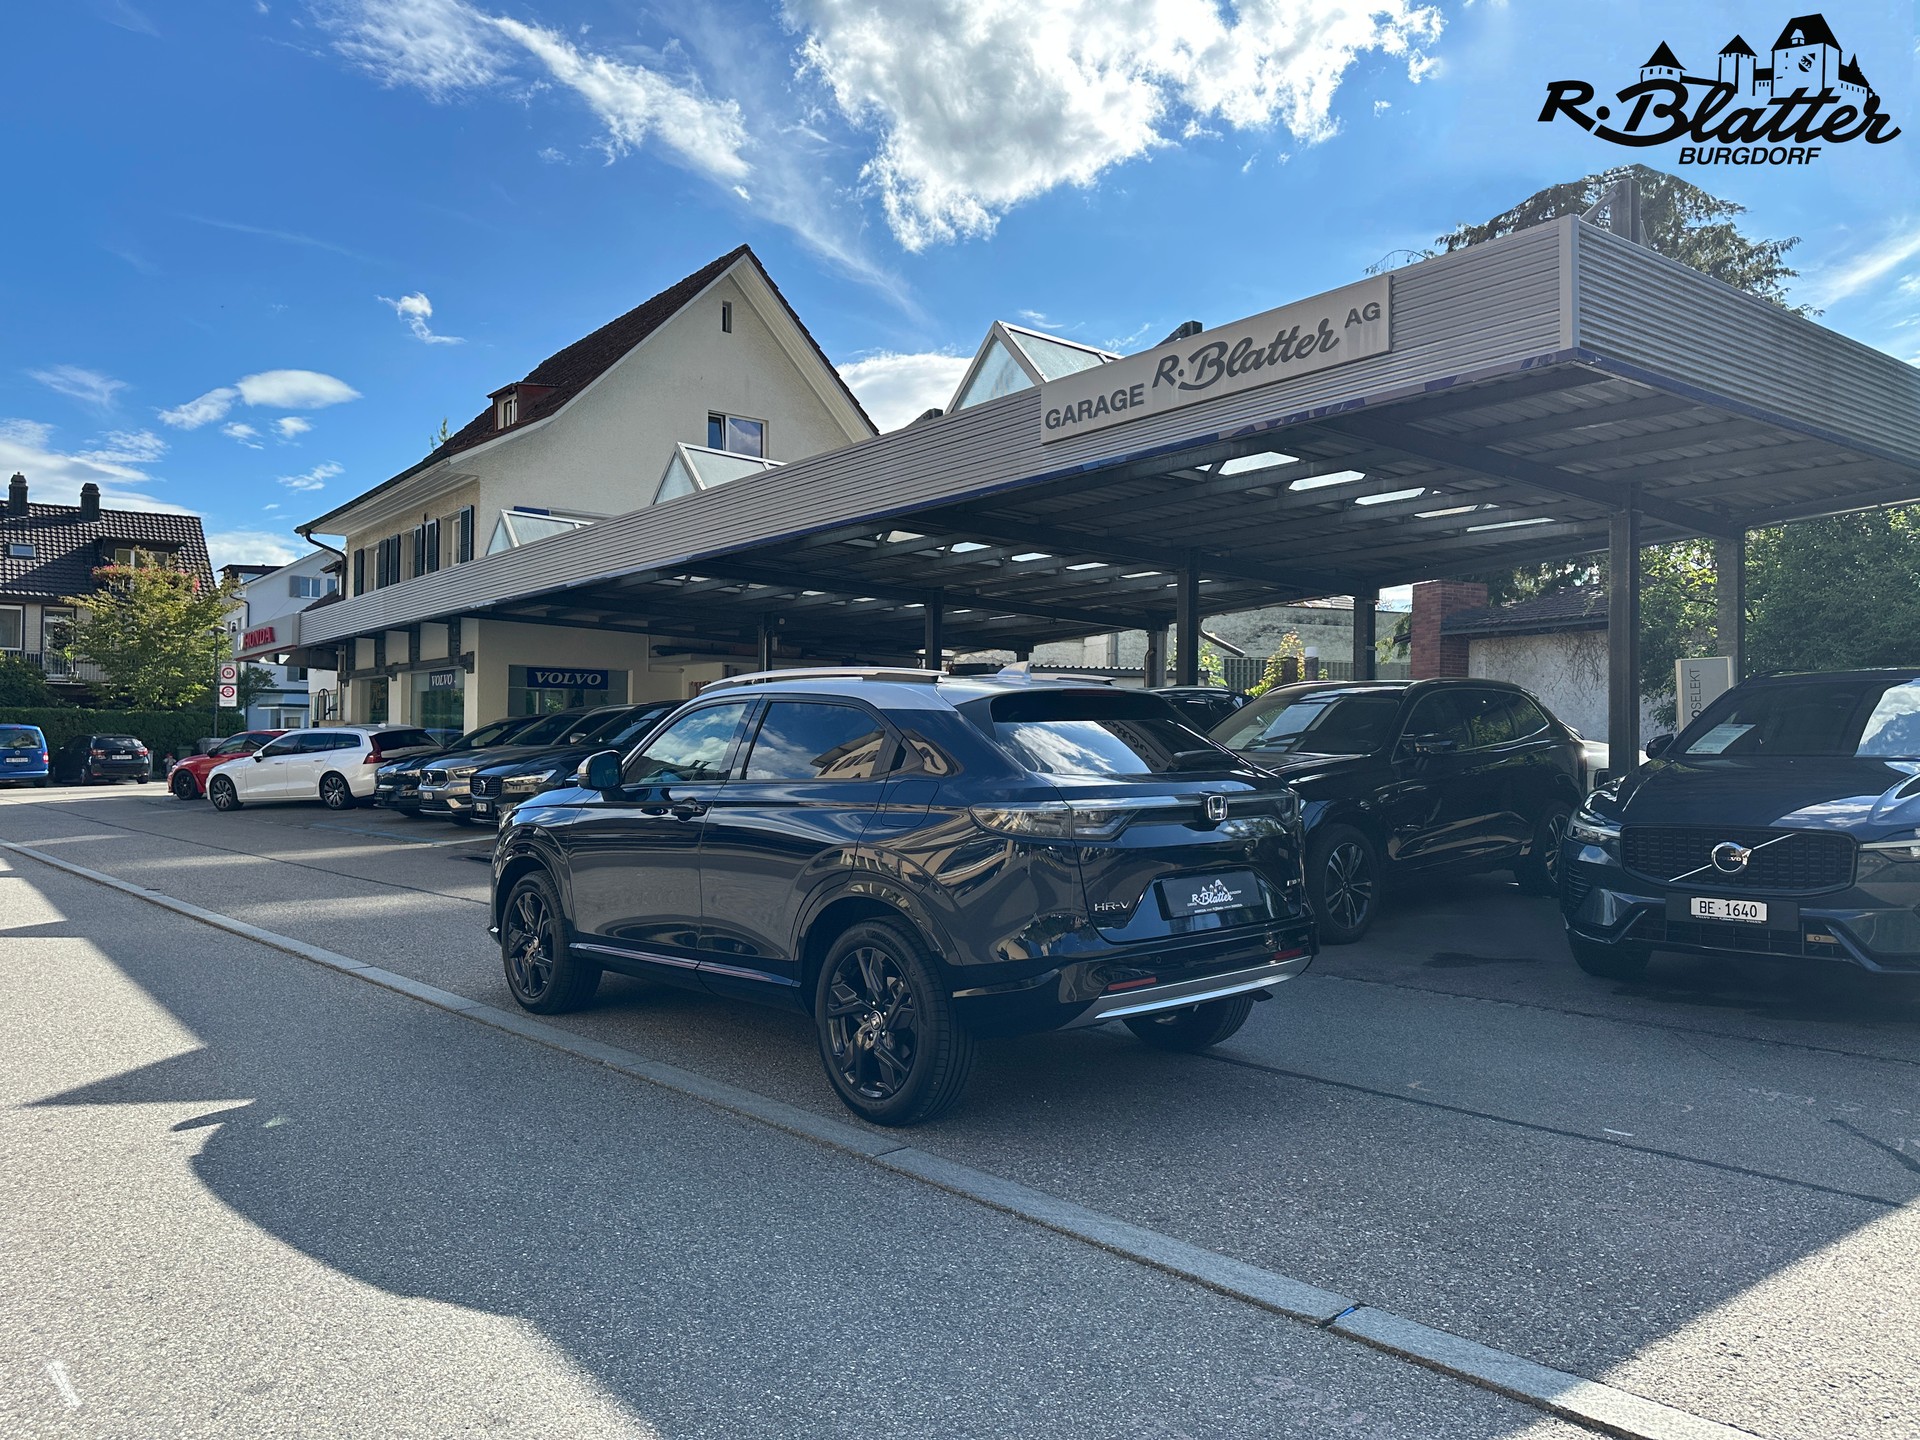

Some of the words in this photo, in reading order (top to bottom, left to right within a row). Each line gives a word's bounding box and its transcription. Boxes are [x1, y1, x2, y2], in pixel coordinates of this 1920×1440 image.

[1045, 383, 1145, 430] GARAGE
[1345, 302, 1381, 328] AG
[243, 626, 275, 650] HONDA
[431, 673, 453, 686] VOLVO
[535, 671, 602, 685] VOLVO
[1689, 668, 1702, 720] OSELEKT
[1094, 901, 1130, 911] HR-V
[1725, 902, 1758, 918] 1640
